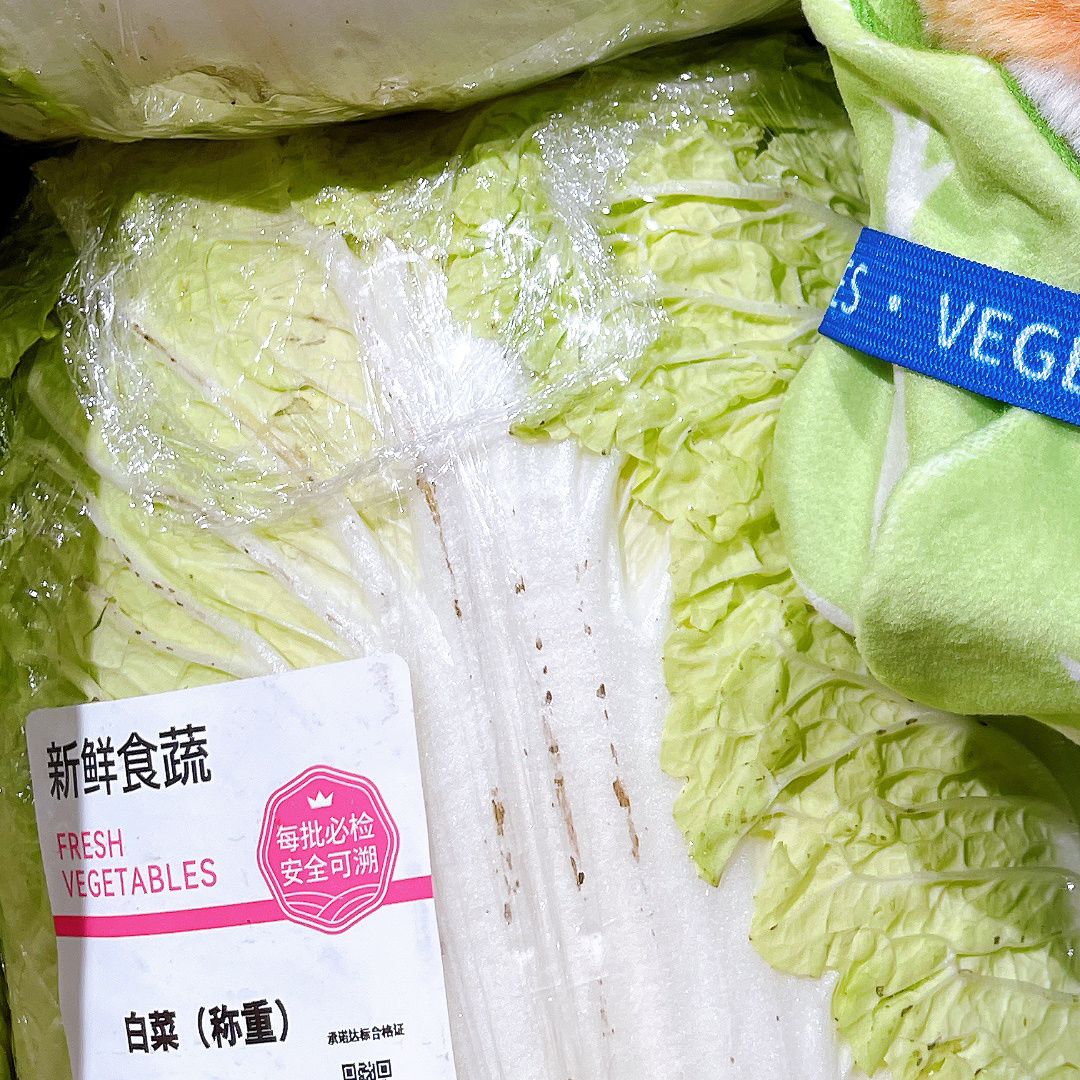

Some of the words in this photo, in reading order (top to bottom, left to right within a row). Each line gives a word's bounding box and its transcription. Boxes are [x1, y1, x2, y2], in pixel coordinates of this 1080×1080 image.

[46, 723, 212, 801] 新鲜食蔬
[57, 828, 124, 861] FRESH
[275, 810, 376, 853] 每批必检
[61, 857, 218, 899] VEGETABLES
[279, 846, 380, 888] 安全可溯
[326, 1022, 406, 1046] 承诺达标合格证
